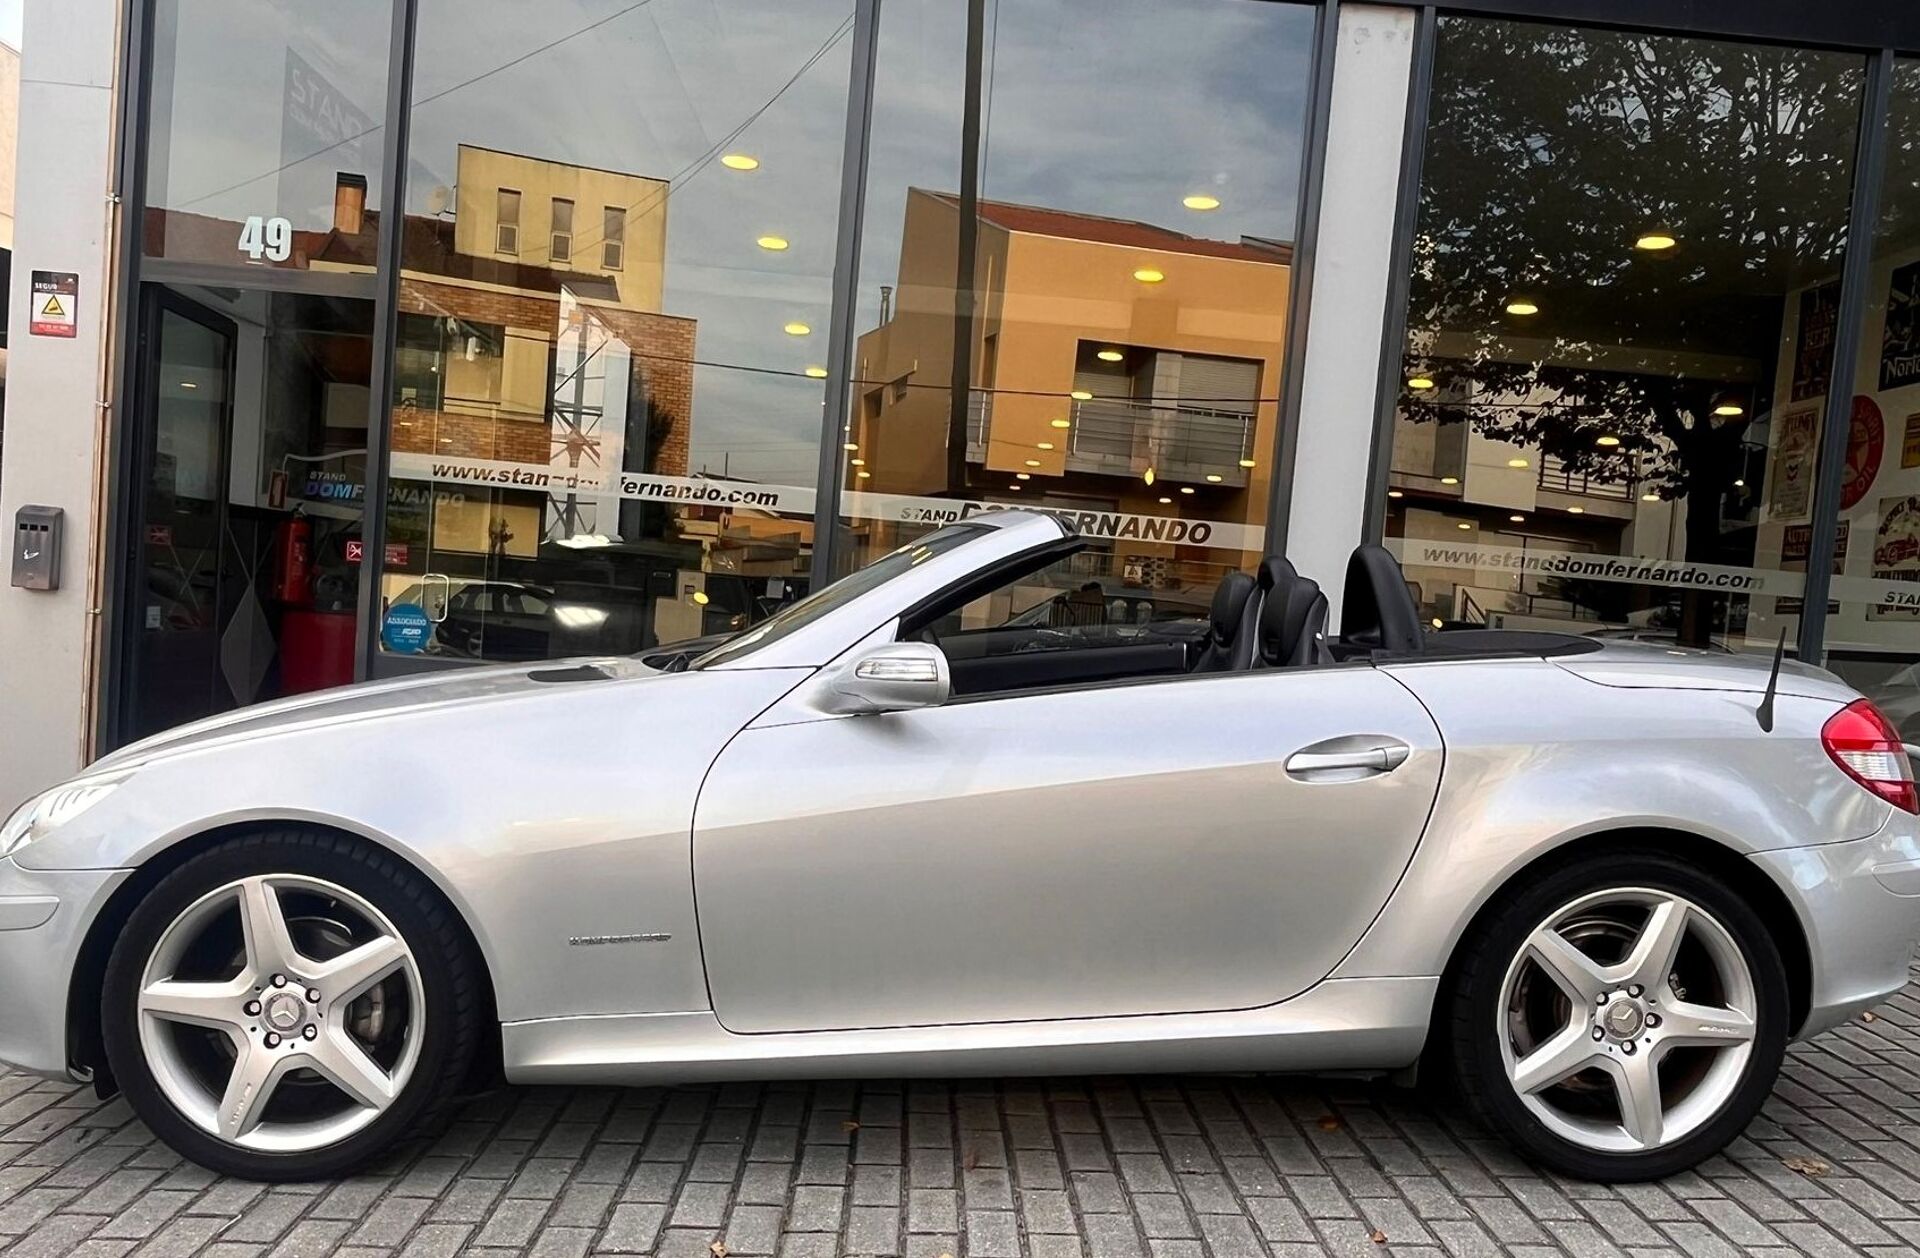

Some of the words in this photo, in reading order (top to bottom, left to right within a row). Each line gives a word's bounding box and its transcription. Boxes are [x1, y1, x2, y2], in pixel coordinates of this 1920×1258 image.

[238, 216, 292, 262] 49
[309, 471, 346, 480] STAND
[900, 506, 957, 523] STAND
[1884, 591, 1920, 605] STA
